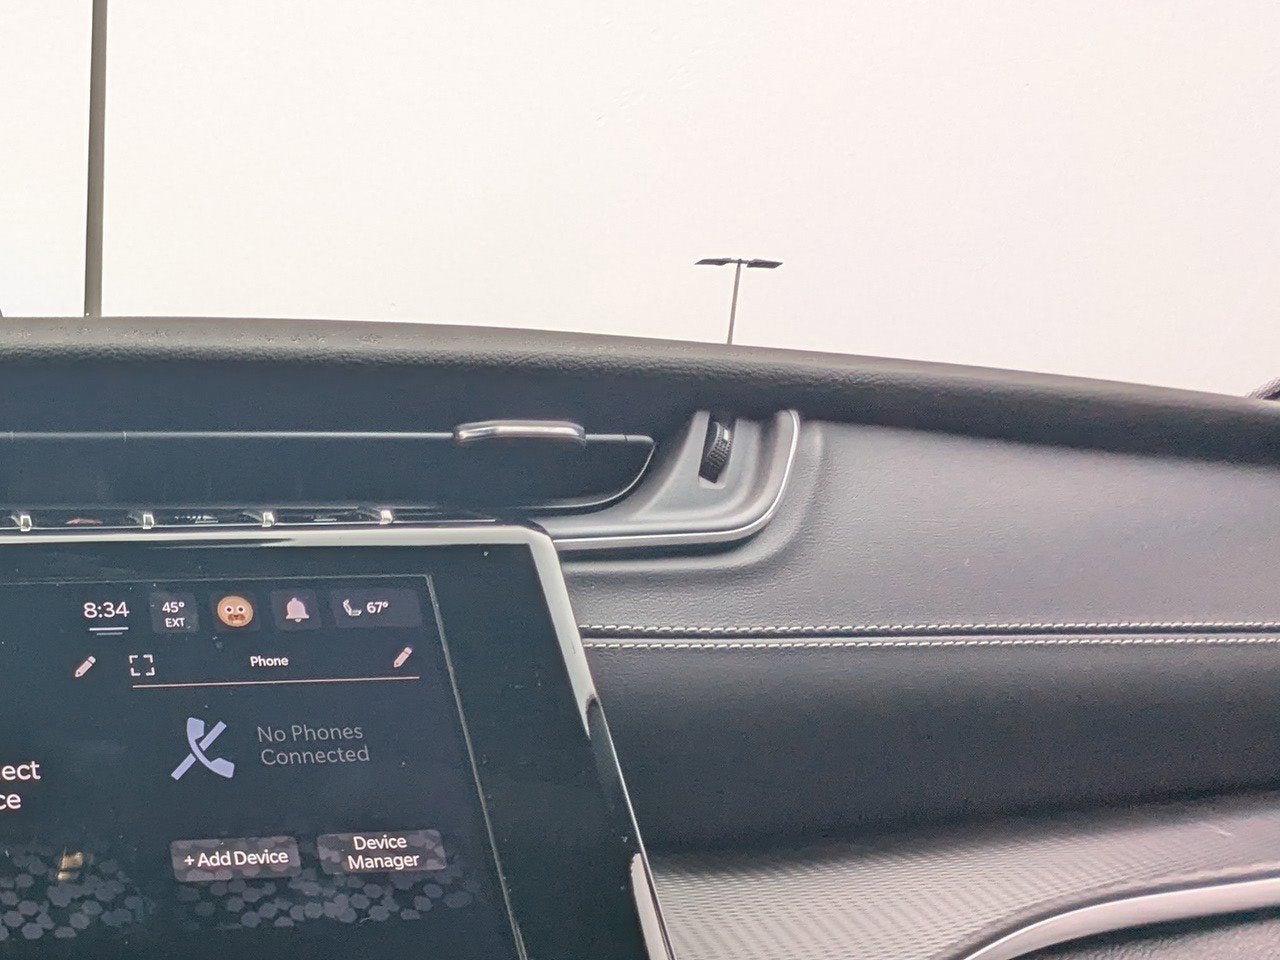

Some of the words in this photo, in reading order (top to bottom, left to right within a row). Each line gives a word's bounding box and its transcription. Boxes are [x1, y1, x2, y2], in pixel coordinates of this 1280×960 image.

[83, 601, 130, 619] 8:34
[162, 601, 185, 614] 45°
[366, 601, 389, 614] 67°
[165, 617, 185, 628] EXT
[250, 655, 289, 668] Phone
[257, 726, 286, 743] No
[291, 724, 364, 742] Phones
[261, 745, 371, 766] Connected
[353, 834, 408, 851] Device
[197, 850, 232, 868] Add
[234, 848, 290, 866] Device
[347, 853, 420, 873] Manager
